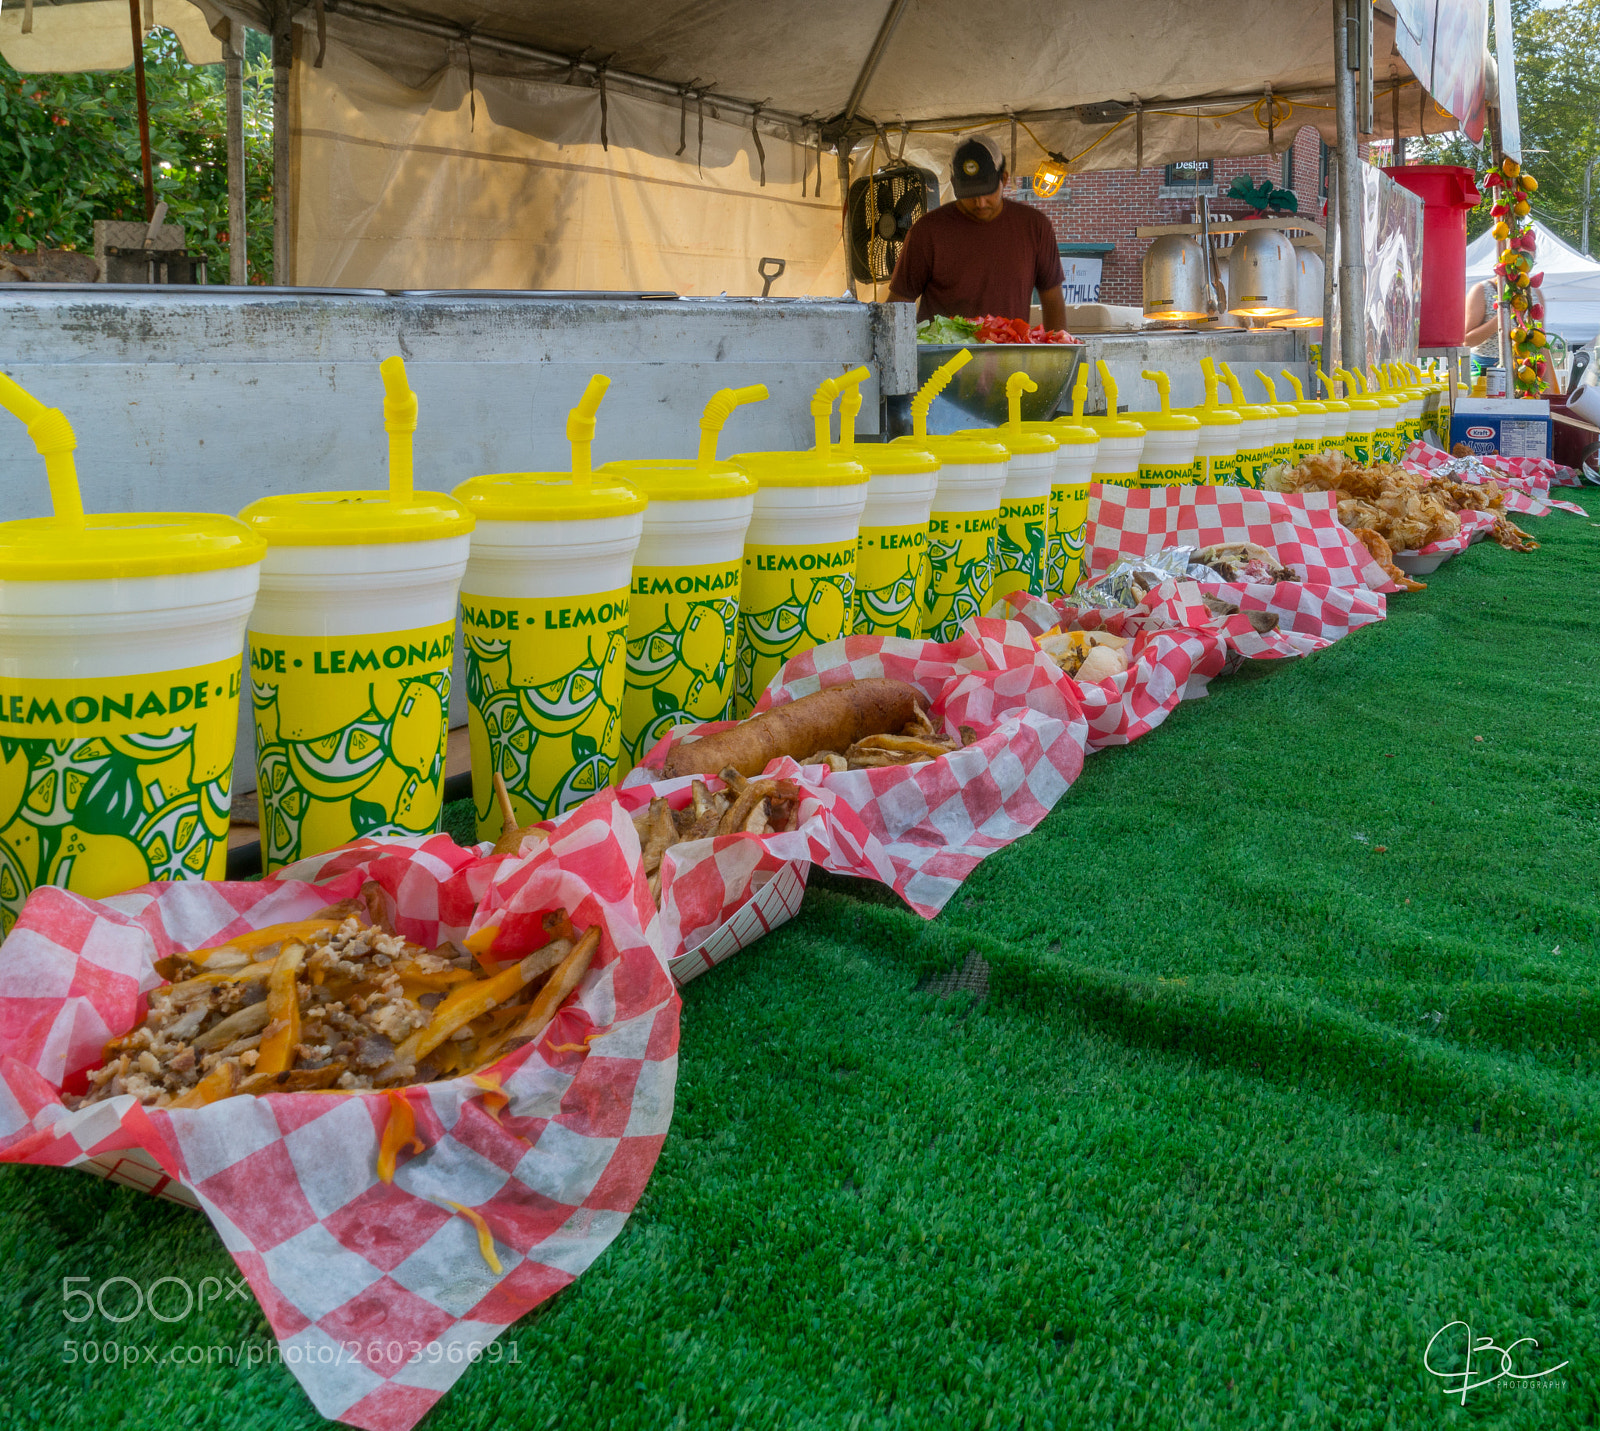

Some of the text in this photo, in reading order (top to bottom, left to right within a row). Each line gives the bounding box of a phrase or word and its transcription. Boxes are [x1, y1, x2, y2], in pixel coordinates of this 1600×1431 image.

[1175, 160, 1208, 170] Design
[757, 547, 855, 572] LEMONADE
[631, 568, 739, 595] LEMONADE
[0, 681, 209, 725] LEMONADE
